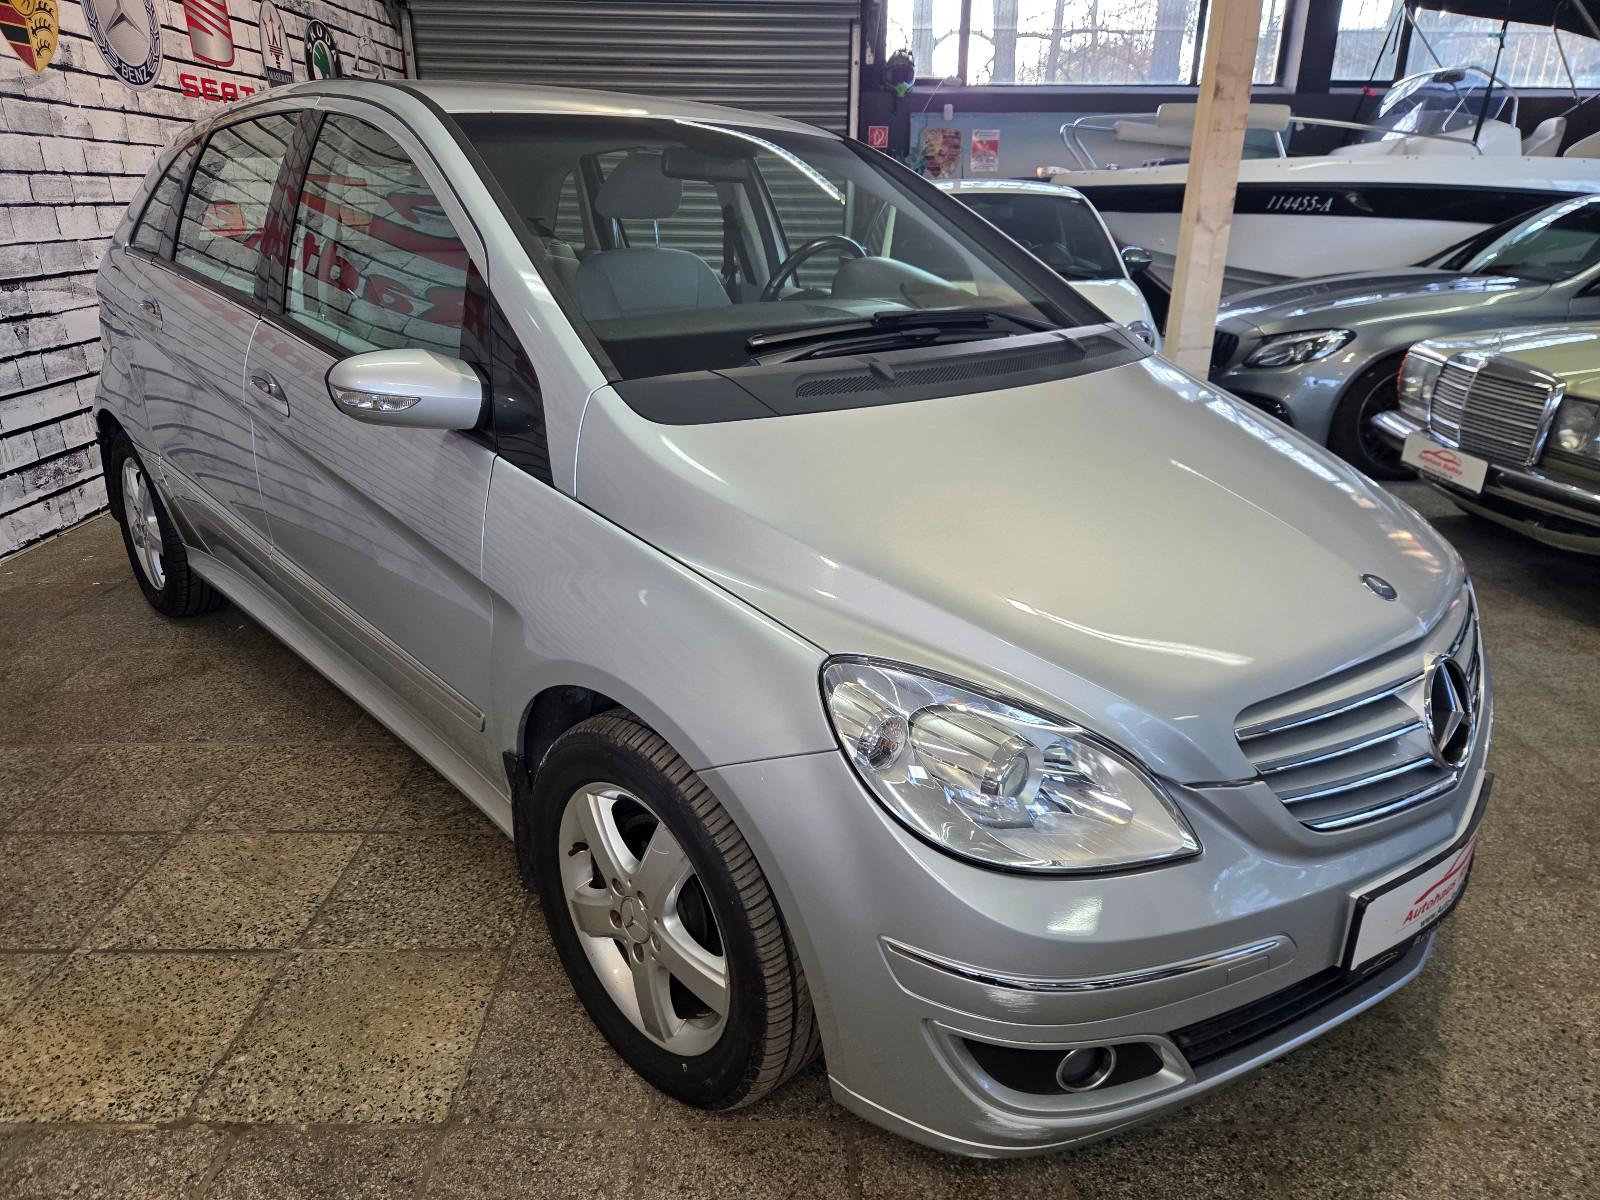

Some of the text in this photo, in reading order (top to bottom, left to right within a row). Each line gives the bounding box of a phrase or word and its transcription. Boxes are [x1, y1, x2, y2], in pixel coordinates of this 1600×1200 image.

[121, 63, 150, 83] BENZ
[179, 73, 255, 103] SEAT
[1266, 195, 1333, 211] 114455-A
